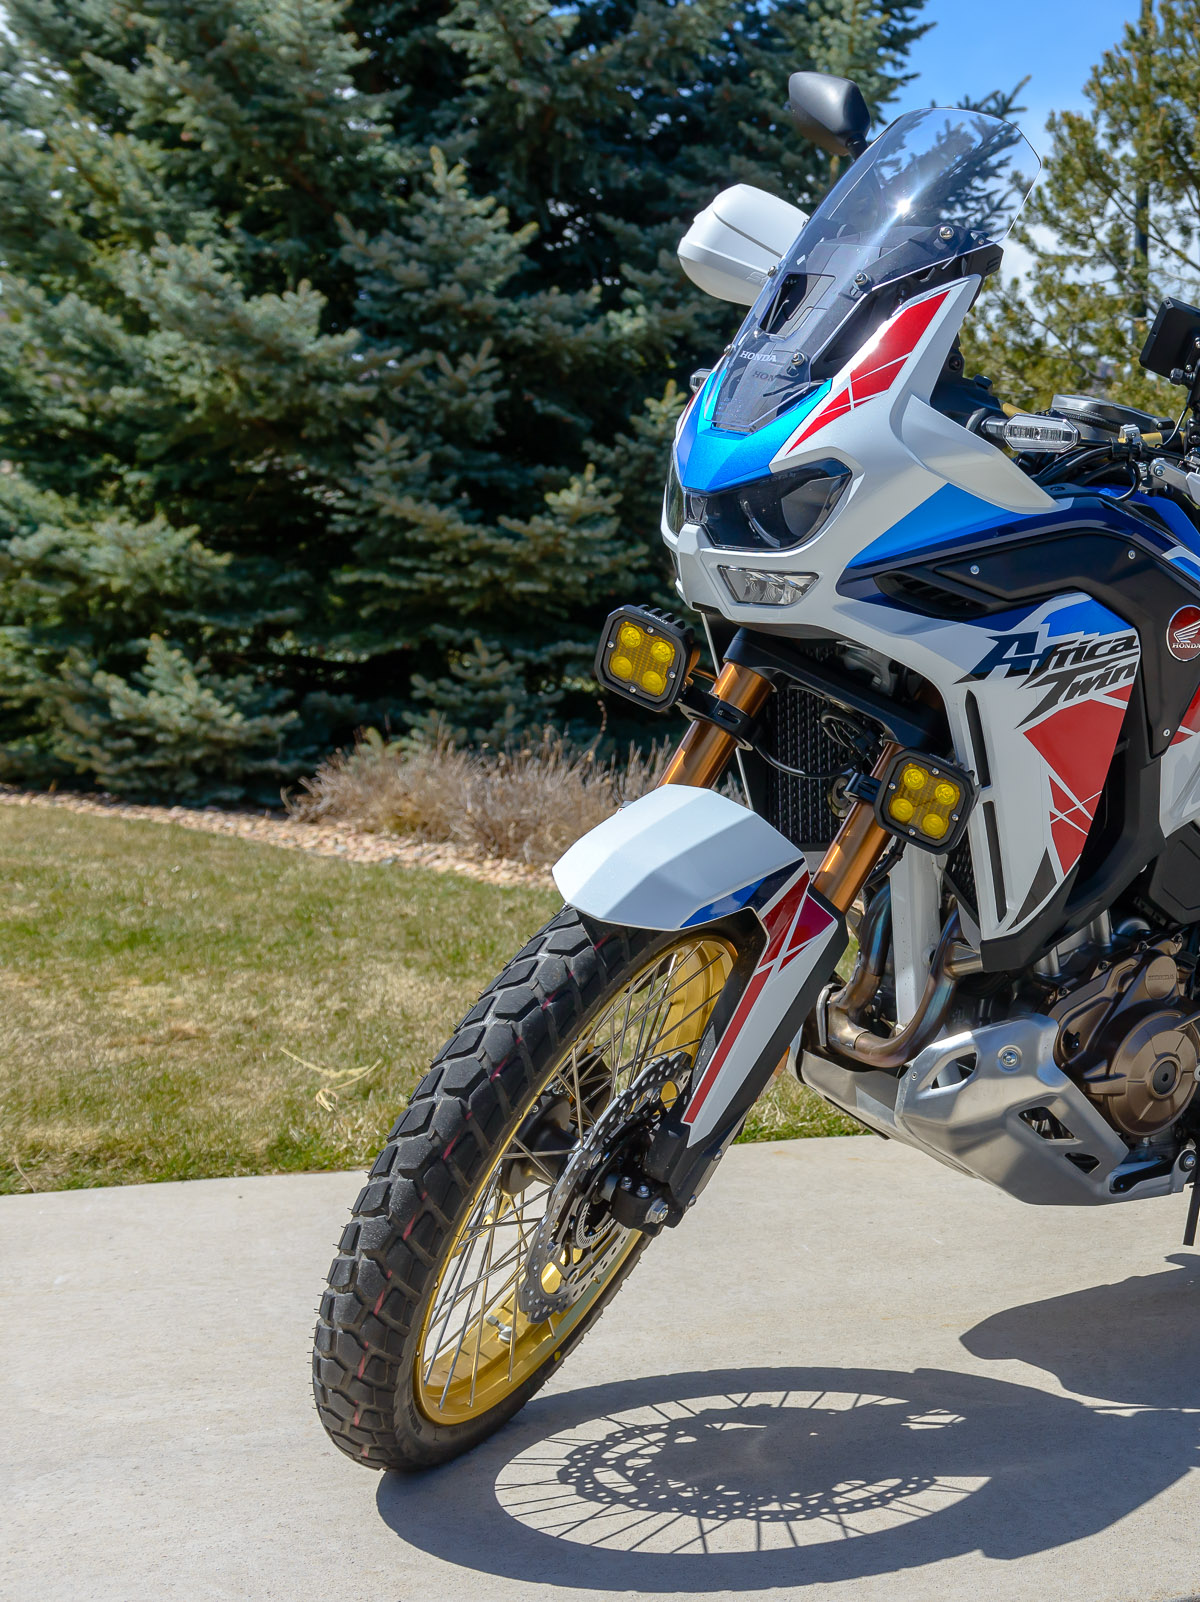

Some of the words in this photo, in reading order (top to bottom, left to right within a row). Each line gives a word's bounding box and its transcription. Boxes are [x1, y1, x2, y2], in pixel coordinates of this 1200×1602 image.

[739, 351, 777, 362] HONDA
[952, 631, 1140, 690] Africa
[1014, 651, 1140, 730] Twin
